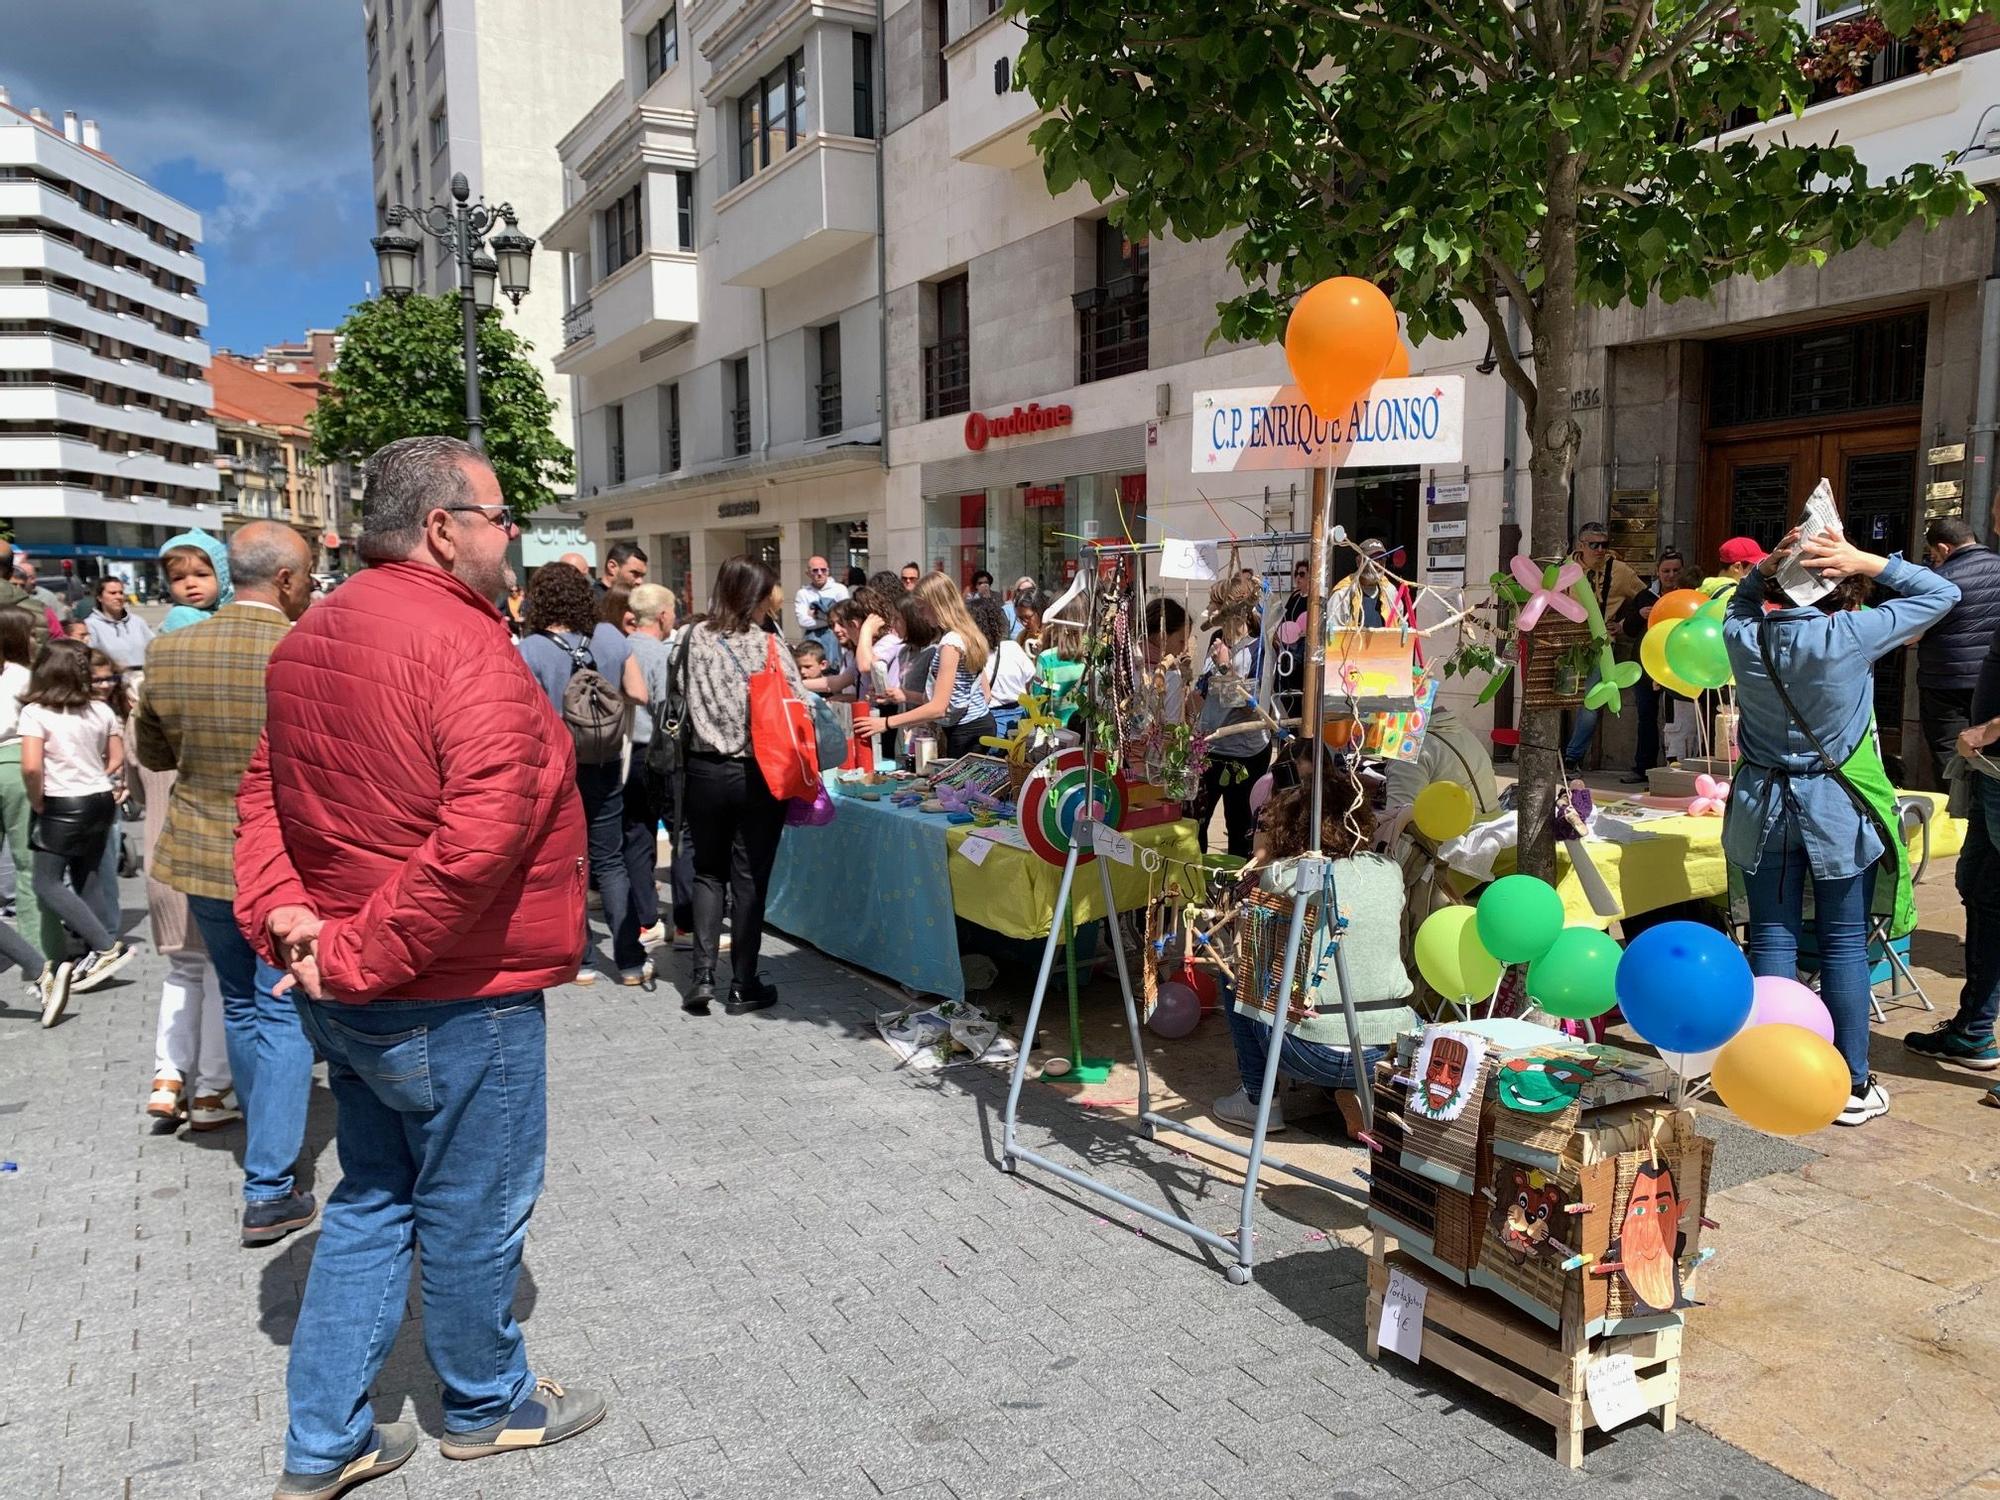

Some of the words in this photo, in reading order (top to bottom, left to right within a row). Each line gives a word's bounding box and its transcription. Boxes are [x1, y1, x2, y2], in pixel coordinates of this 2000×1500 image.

[987, 403, 1072, 438] vodafone
[1212, 406, 1244, 450] C.P.
[1249, 403, 1342, 456] ENRIQUE
[1346, 395, 1440, 443] ALONSO
